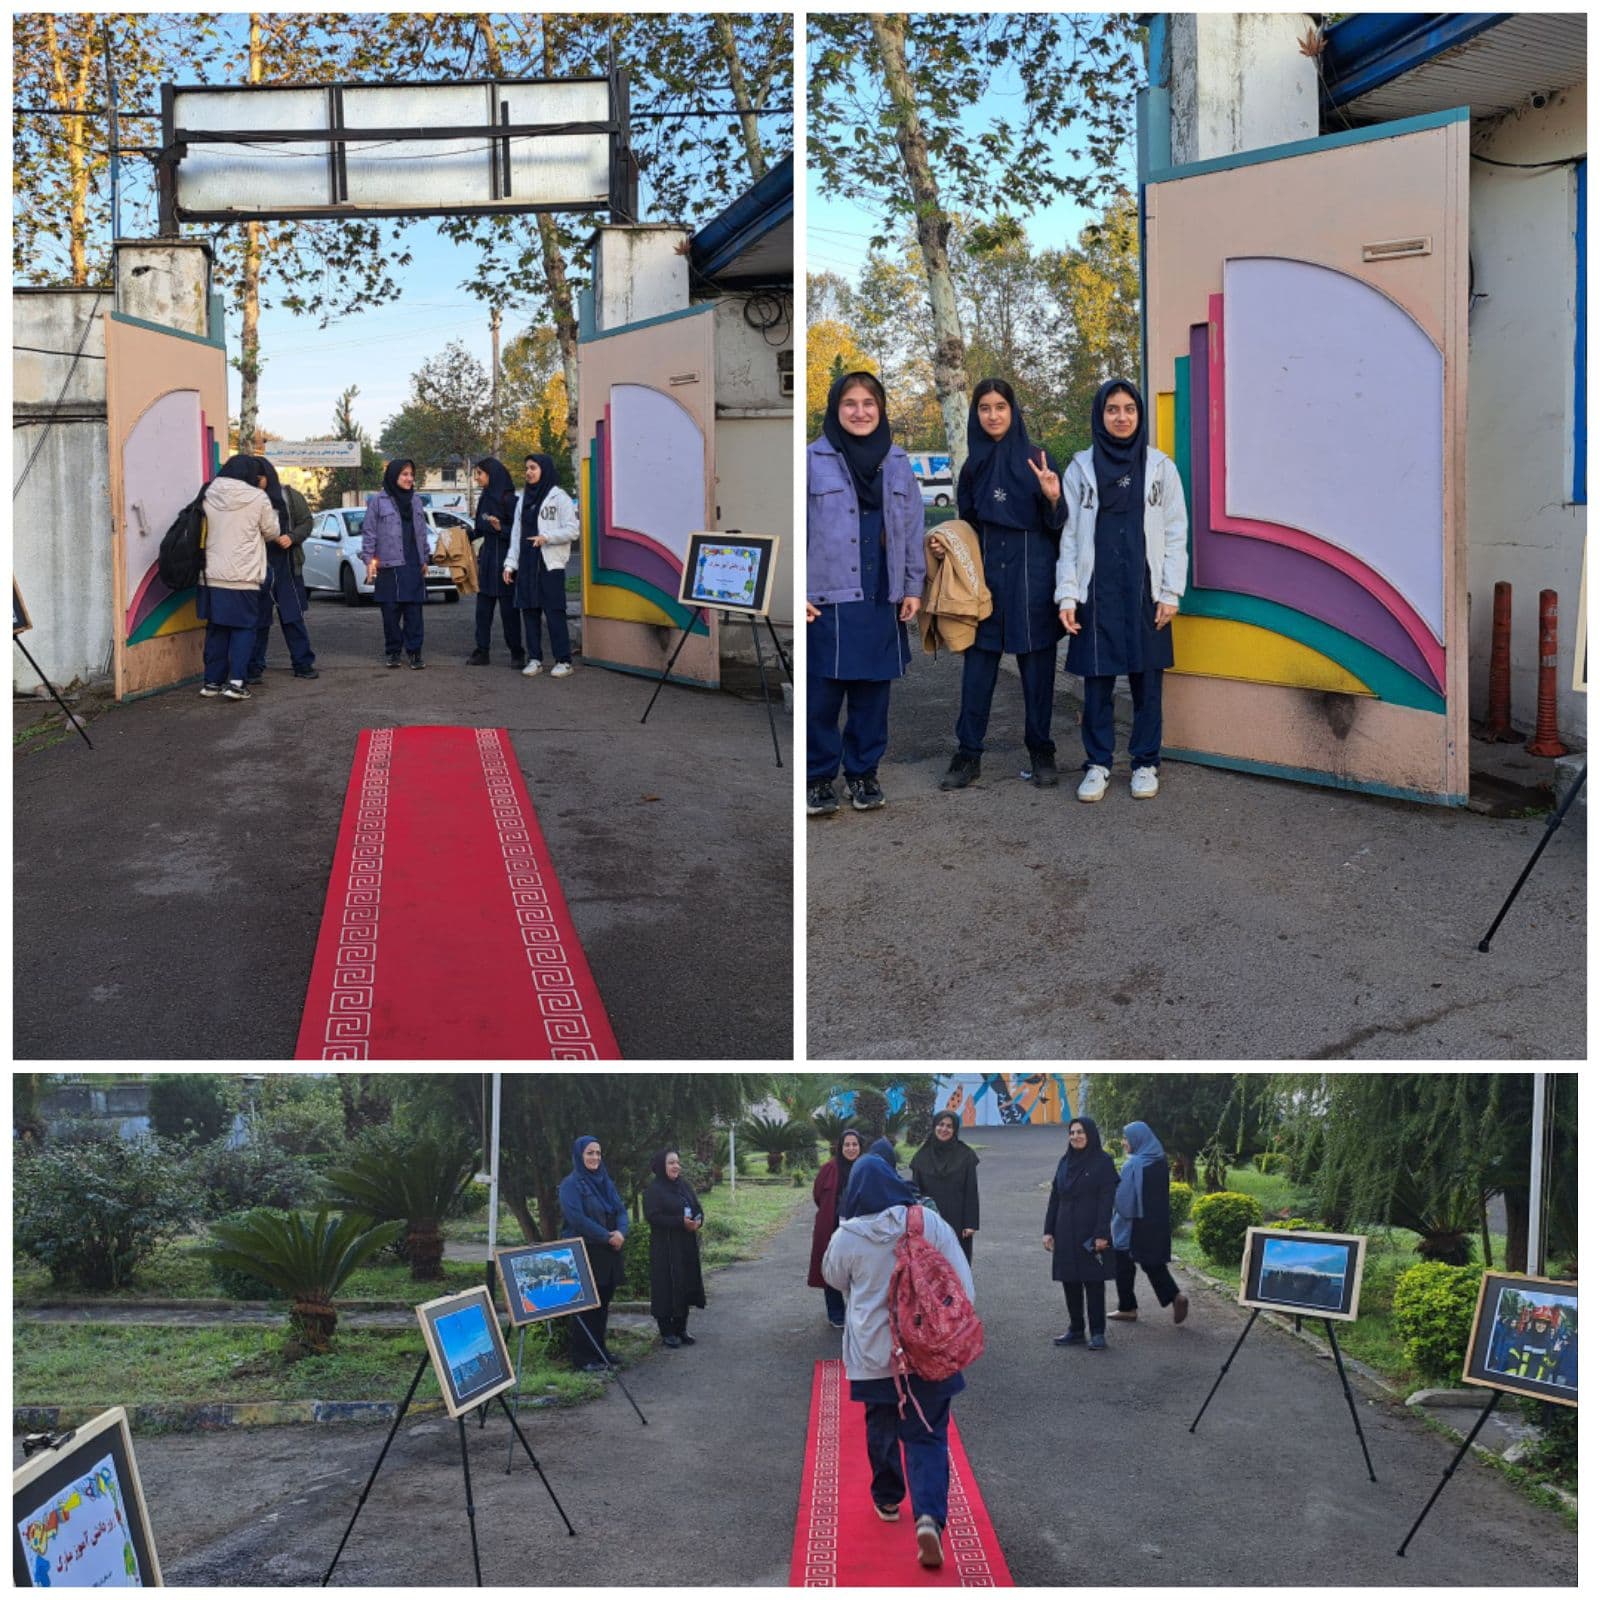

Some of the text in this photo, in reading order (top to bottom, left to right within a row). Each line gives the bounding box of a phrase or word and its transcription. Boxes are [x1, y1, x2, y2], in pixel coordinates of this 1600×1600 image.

[74, 1531, 88, 1560] آموز
[92, 1520, 106, 1546] دانش
[57, 1551, 73, 1573] مبارک
